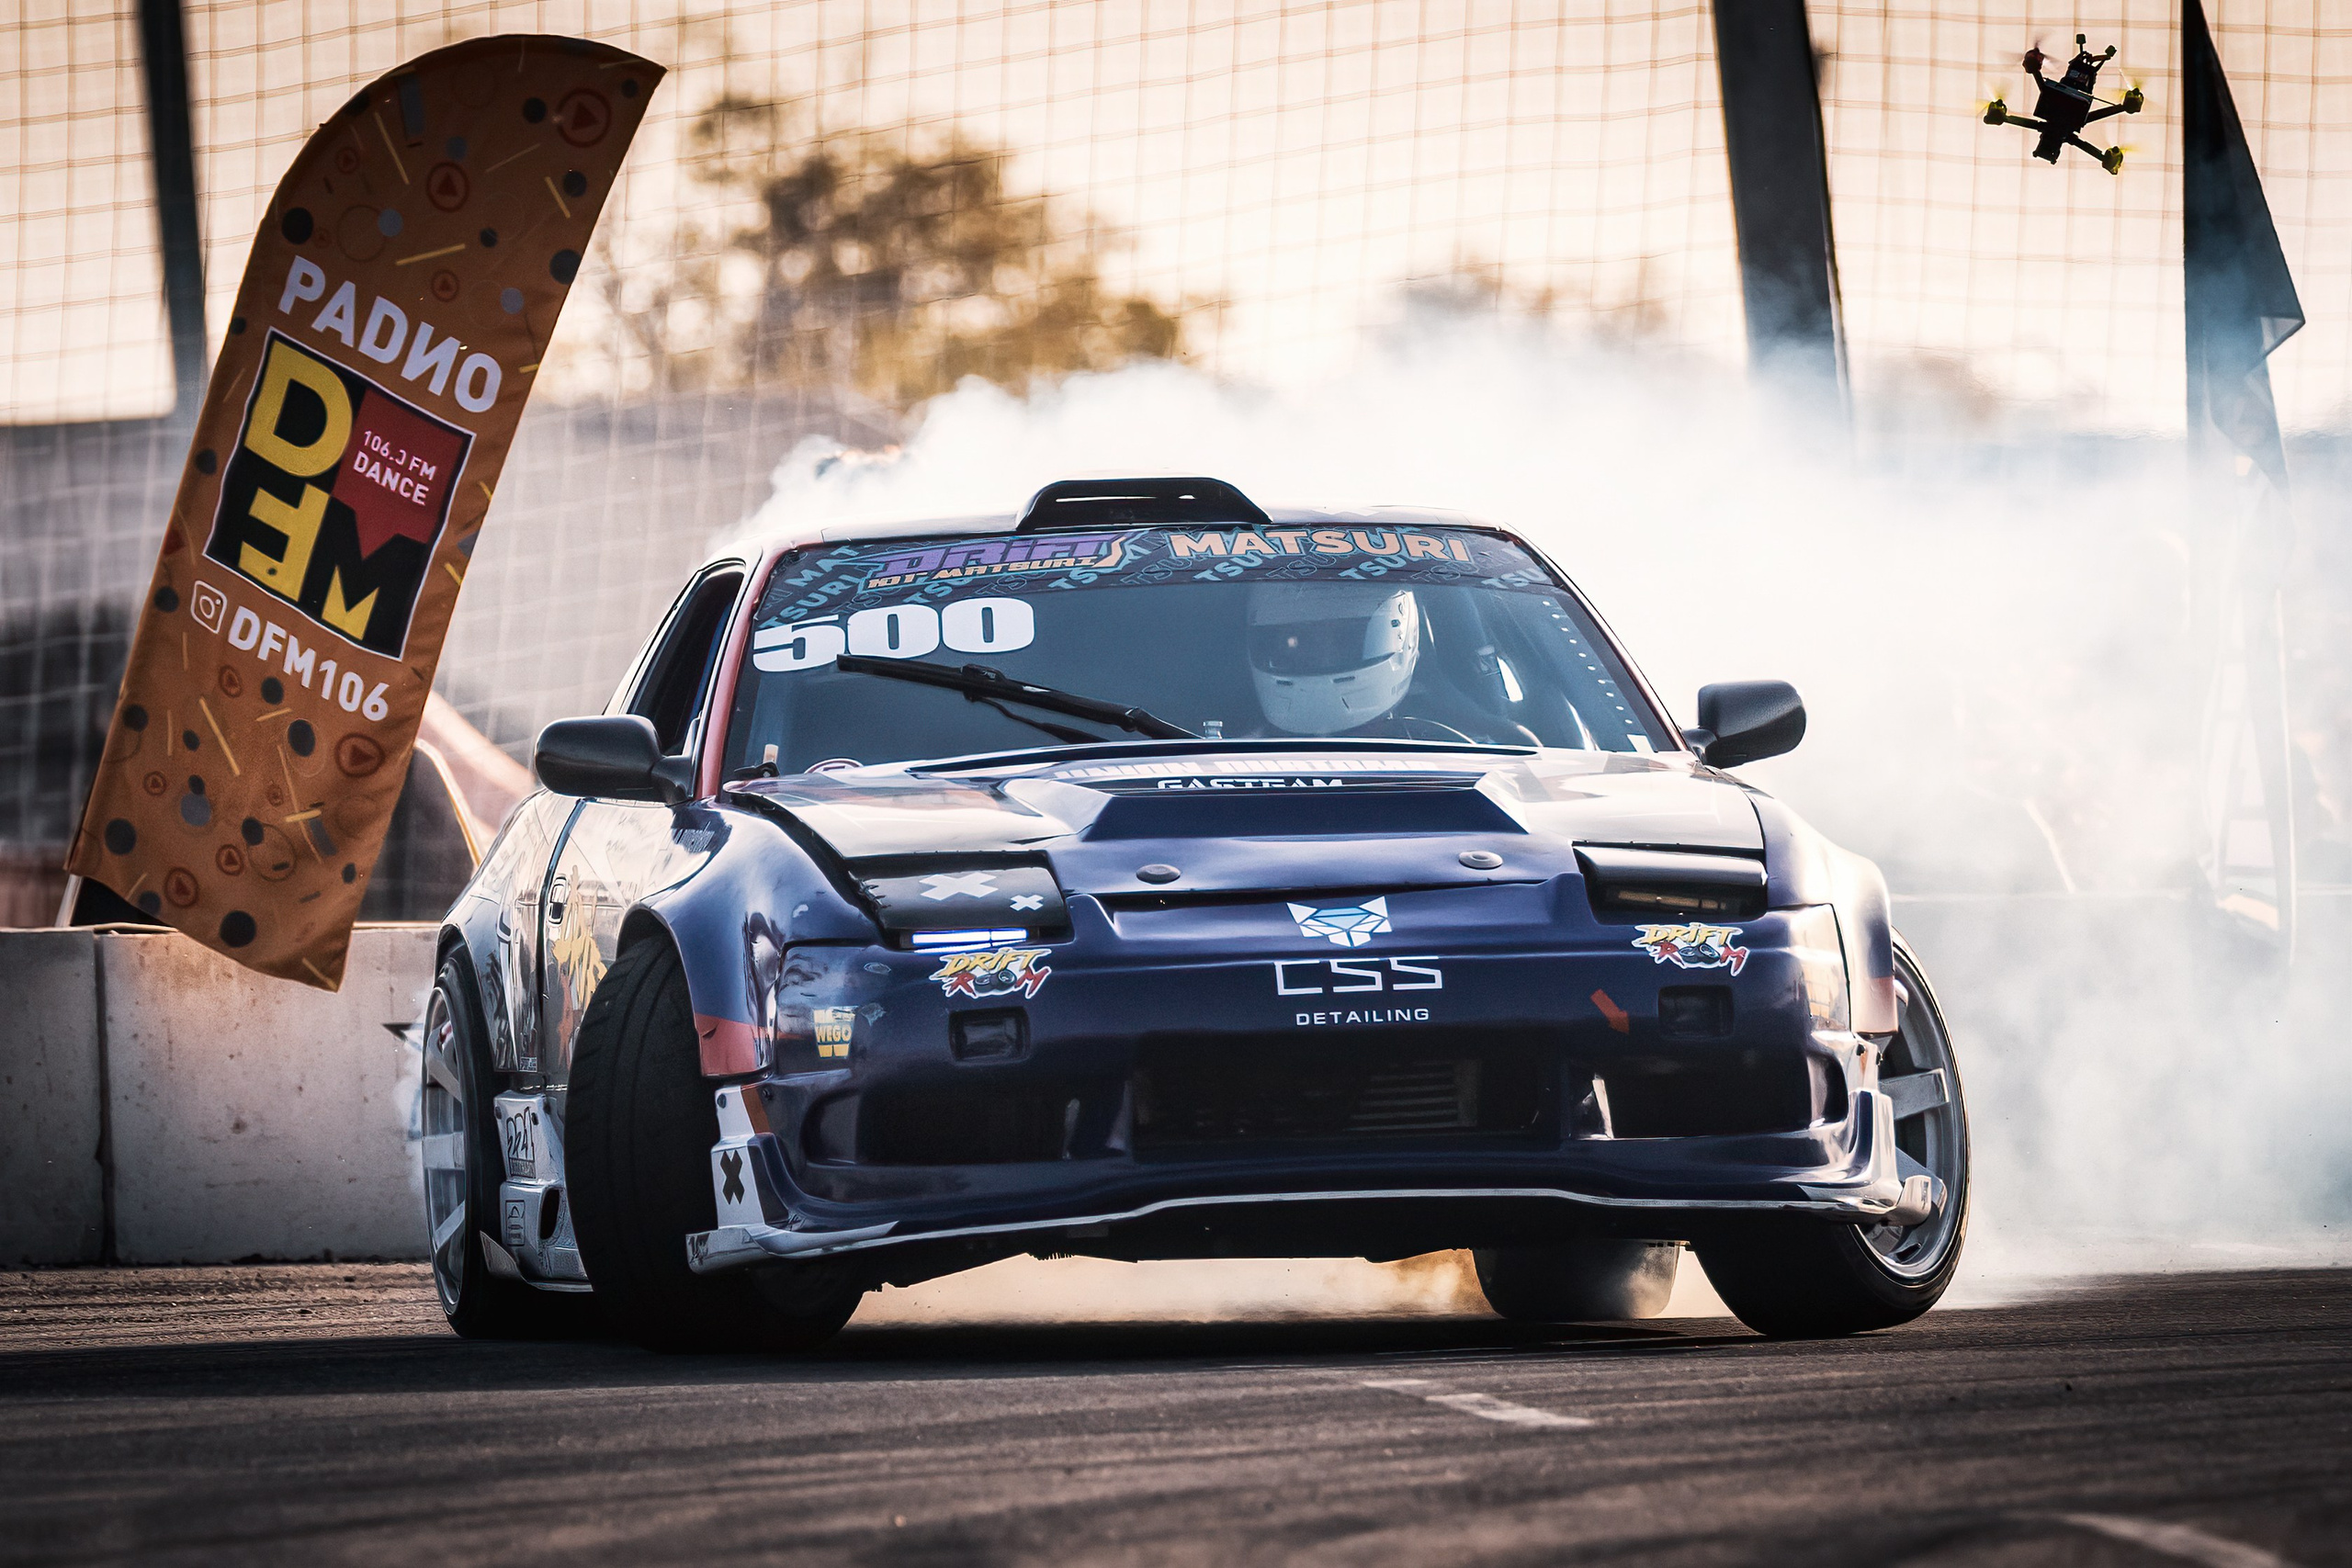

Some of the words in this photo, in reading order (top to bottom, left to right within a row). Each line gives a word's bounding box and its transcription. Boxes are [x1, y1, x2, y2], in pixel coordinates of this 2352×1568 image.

[353, 450, 429, 506] DANCE
[408, 456, 436, 480] FM
[865, 533, 1128, 580] DRIFT
[1168, 530, 1470, 562] MATSURI
[932, 556, 1099, 581] MATSURI
[753, 597, 1035, 672] 500
[228, 605, 390, 721] DFM106
[1637, 923, 1739, 945] DRIFT
[936, 948, 1047, 977] DRIFT
[1273, 956, 1442, 996] CSS
[1295, 1009, 1430, 1026] DETAILING
